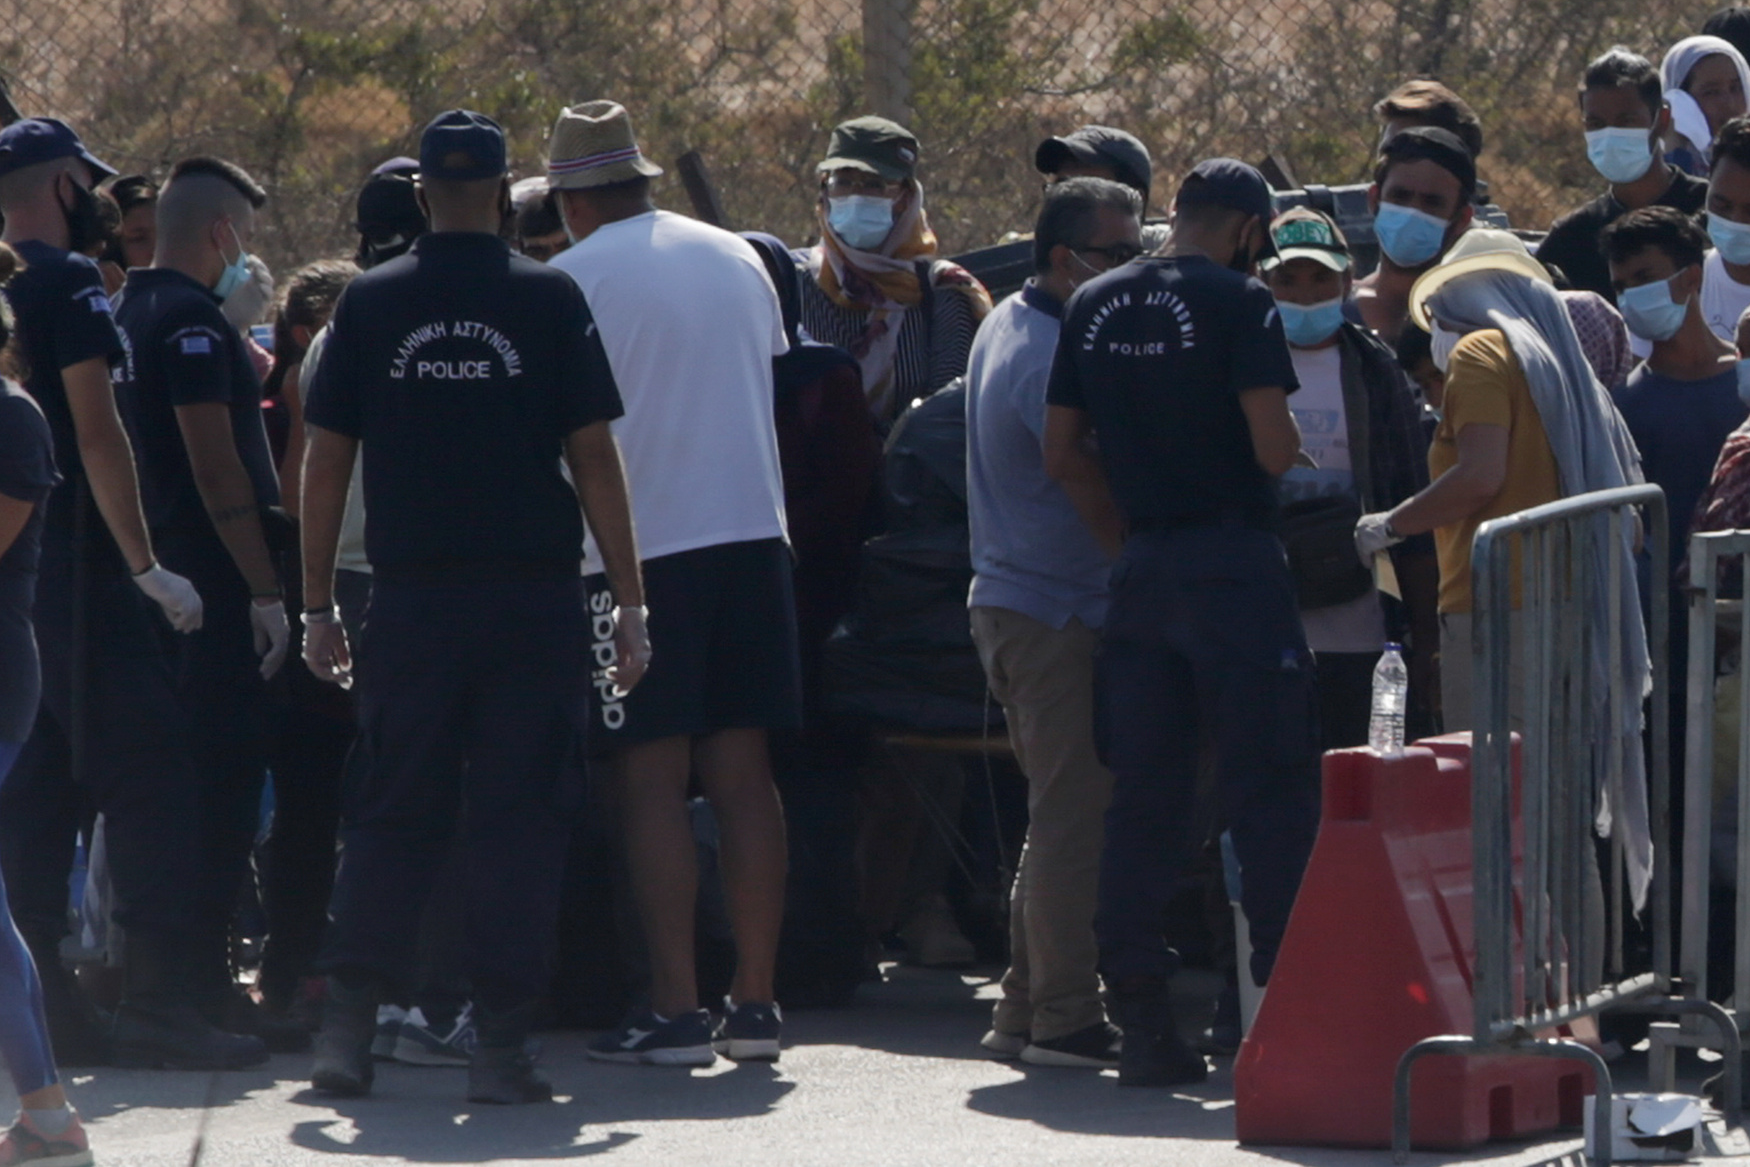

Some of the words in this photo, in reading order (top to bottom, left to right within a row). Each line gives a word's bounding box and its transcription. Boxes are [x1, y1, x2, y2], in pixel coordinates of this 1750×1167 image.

[390, 321, 446, 379] ΕΛΛΗΝΙΚΗ
[453, 321, 522, 377] ΑΣΤΥΝΟΜΙΑ
[1109, 342, 1165, 356] POLICE
[417, 361, 491, 380] POLICE
